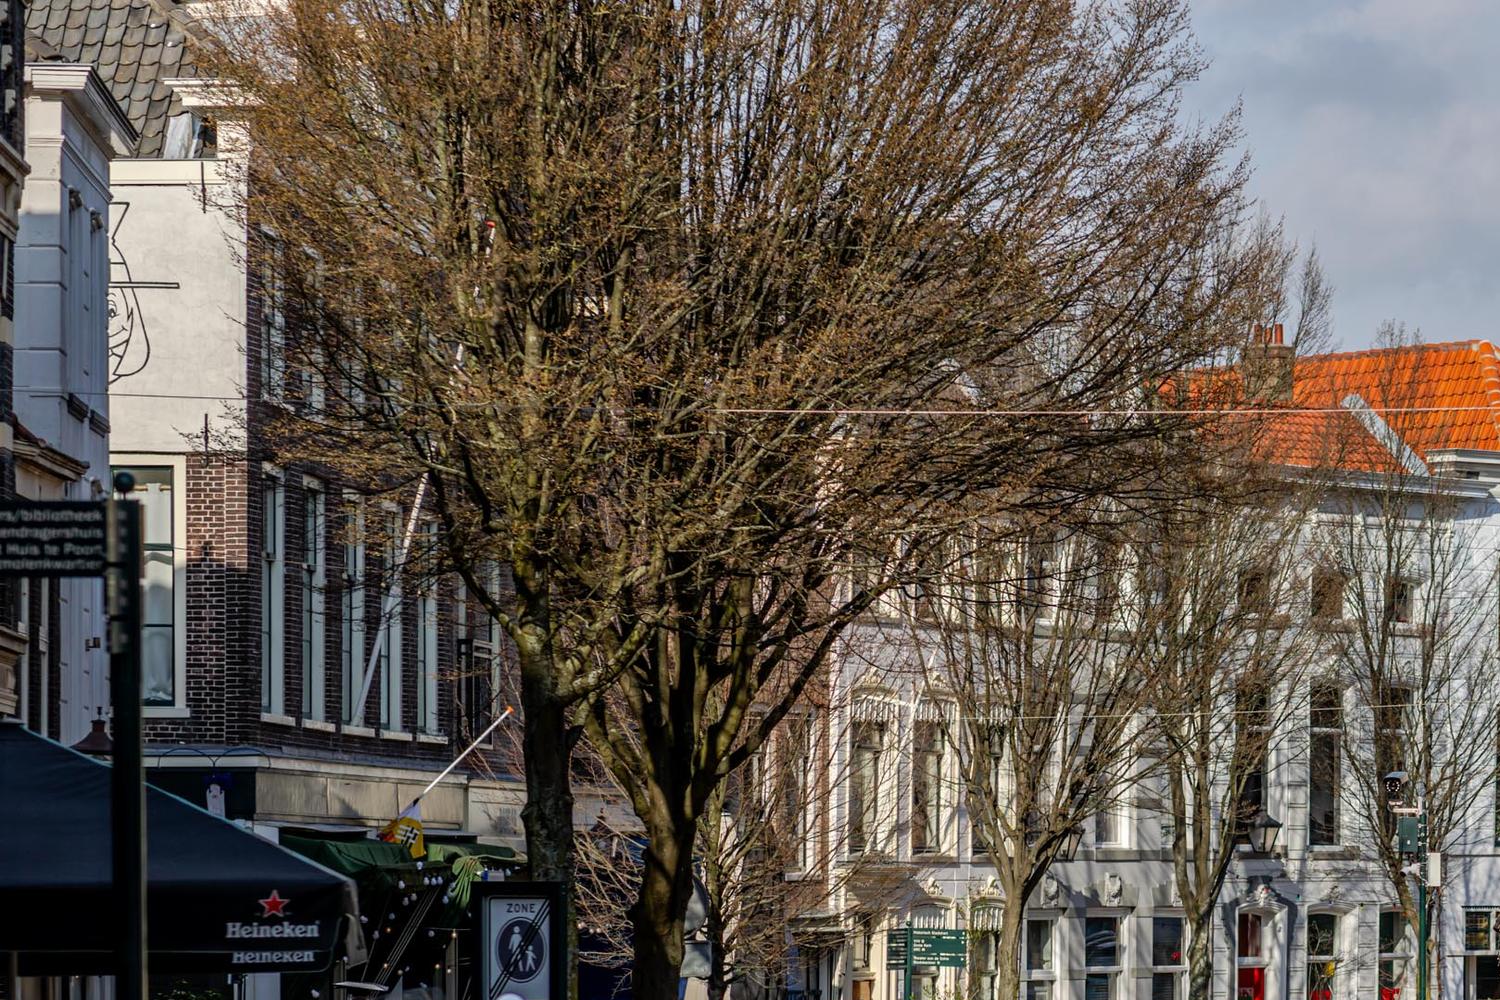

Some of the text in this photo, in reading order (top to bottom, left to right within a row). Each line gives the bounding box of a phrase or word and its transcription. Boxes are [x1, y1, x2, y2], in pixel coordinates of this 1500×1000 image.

[506, 903, 536, 914] ZONE
[225, 921, 319, 938] Heineken
[231, 951, 315, 963] Heineken
